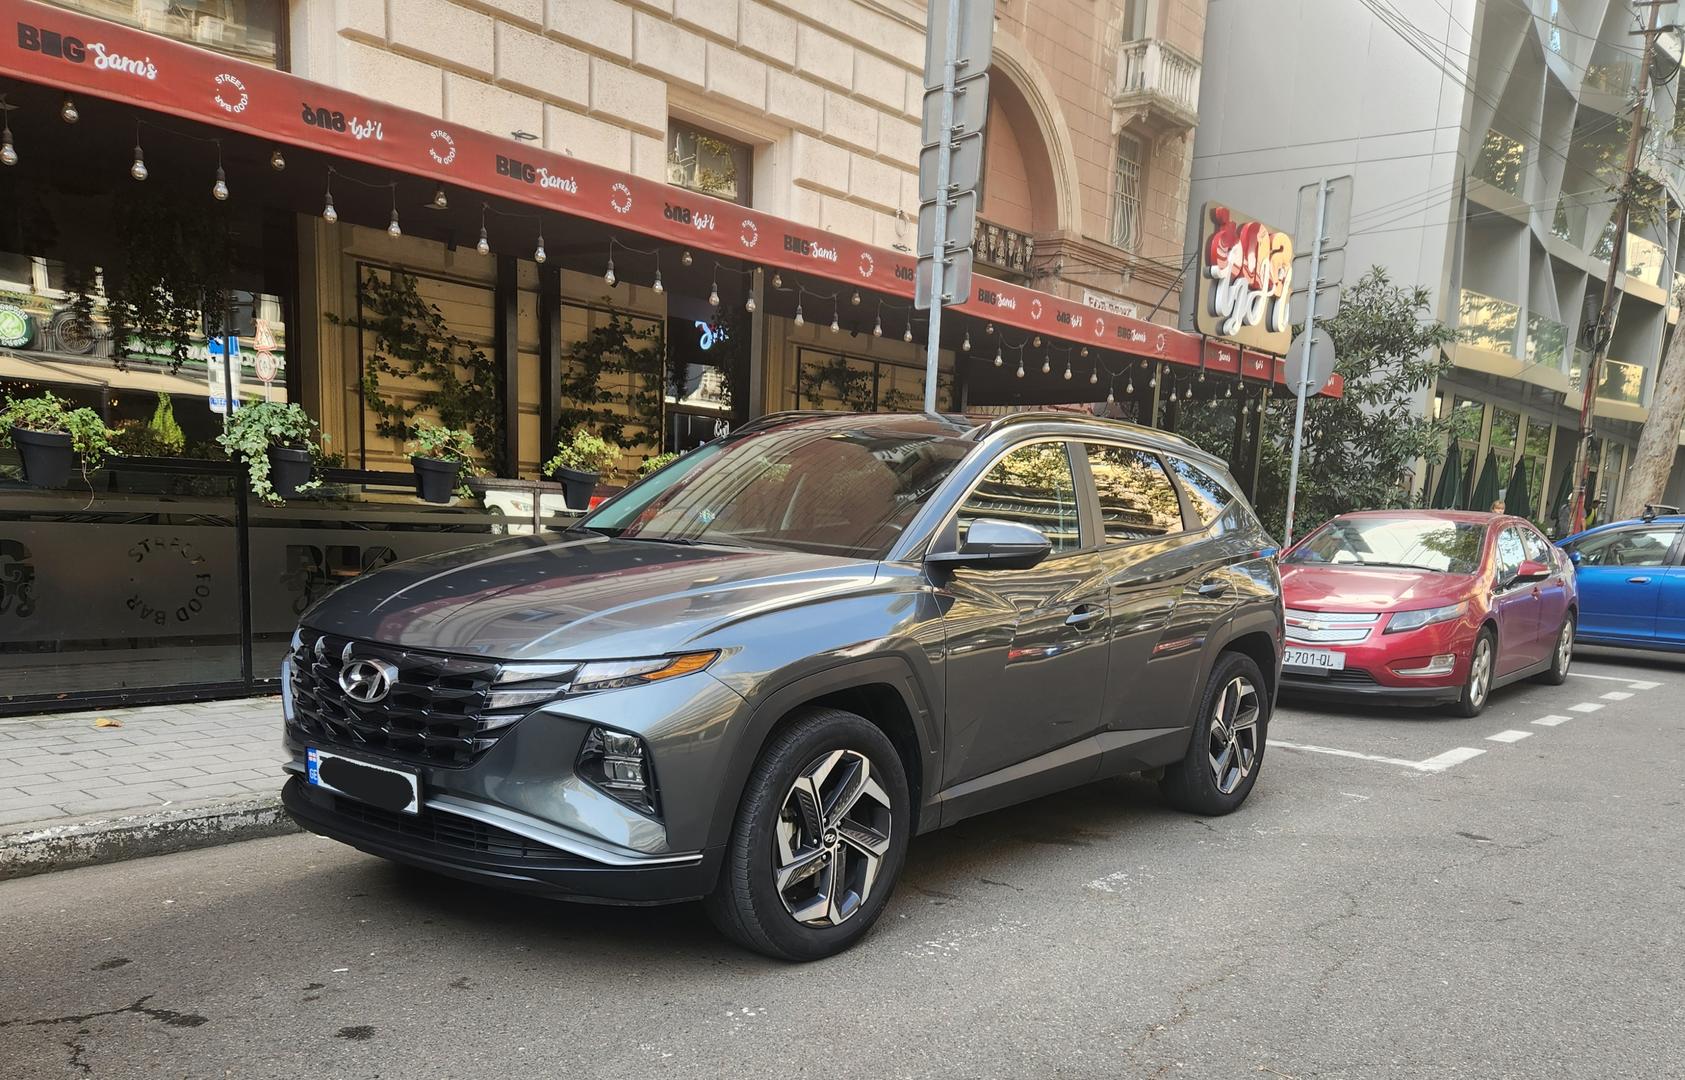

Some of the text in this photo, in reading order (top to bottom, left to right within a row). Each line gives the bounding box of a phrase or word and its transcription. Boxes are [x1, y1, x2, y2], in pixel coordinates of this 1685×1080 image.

[87, 43, 157, 80] Sam's
[215, 74, 249, 113] STREET FOOD BAR
[429, 130, 456, 165] STREET FOOD BAR
[536, 167, 578, 194] Sam's
[810, 241, 838, 262] Sam's
[126, 594, 166, 625] BAR
[175, 573, 211, 622] FOOD
[1283, 650, 1334, 667] Q-701-QL
